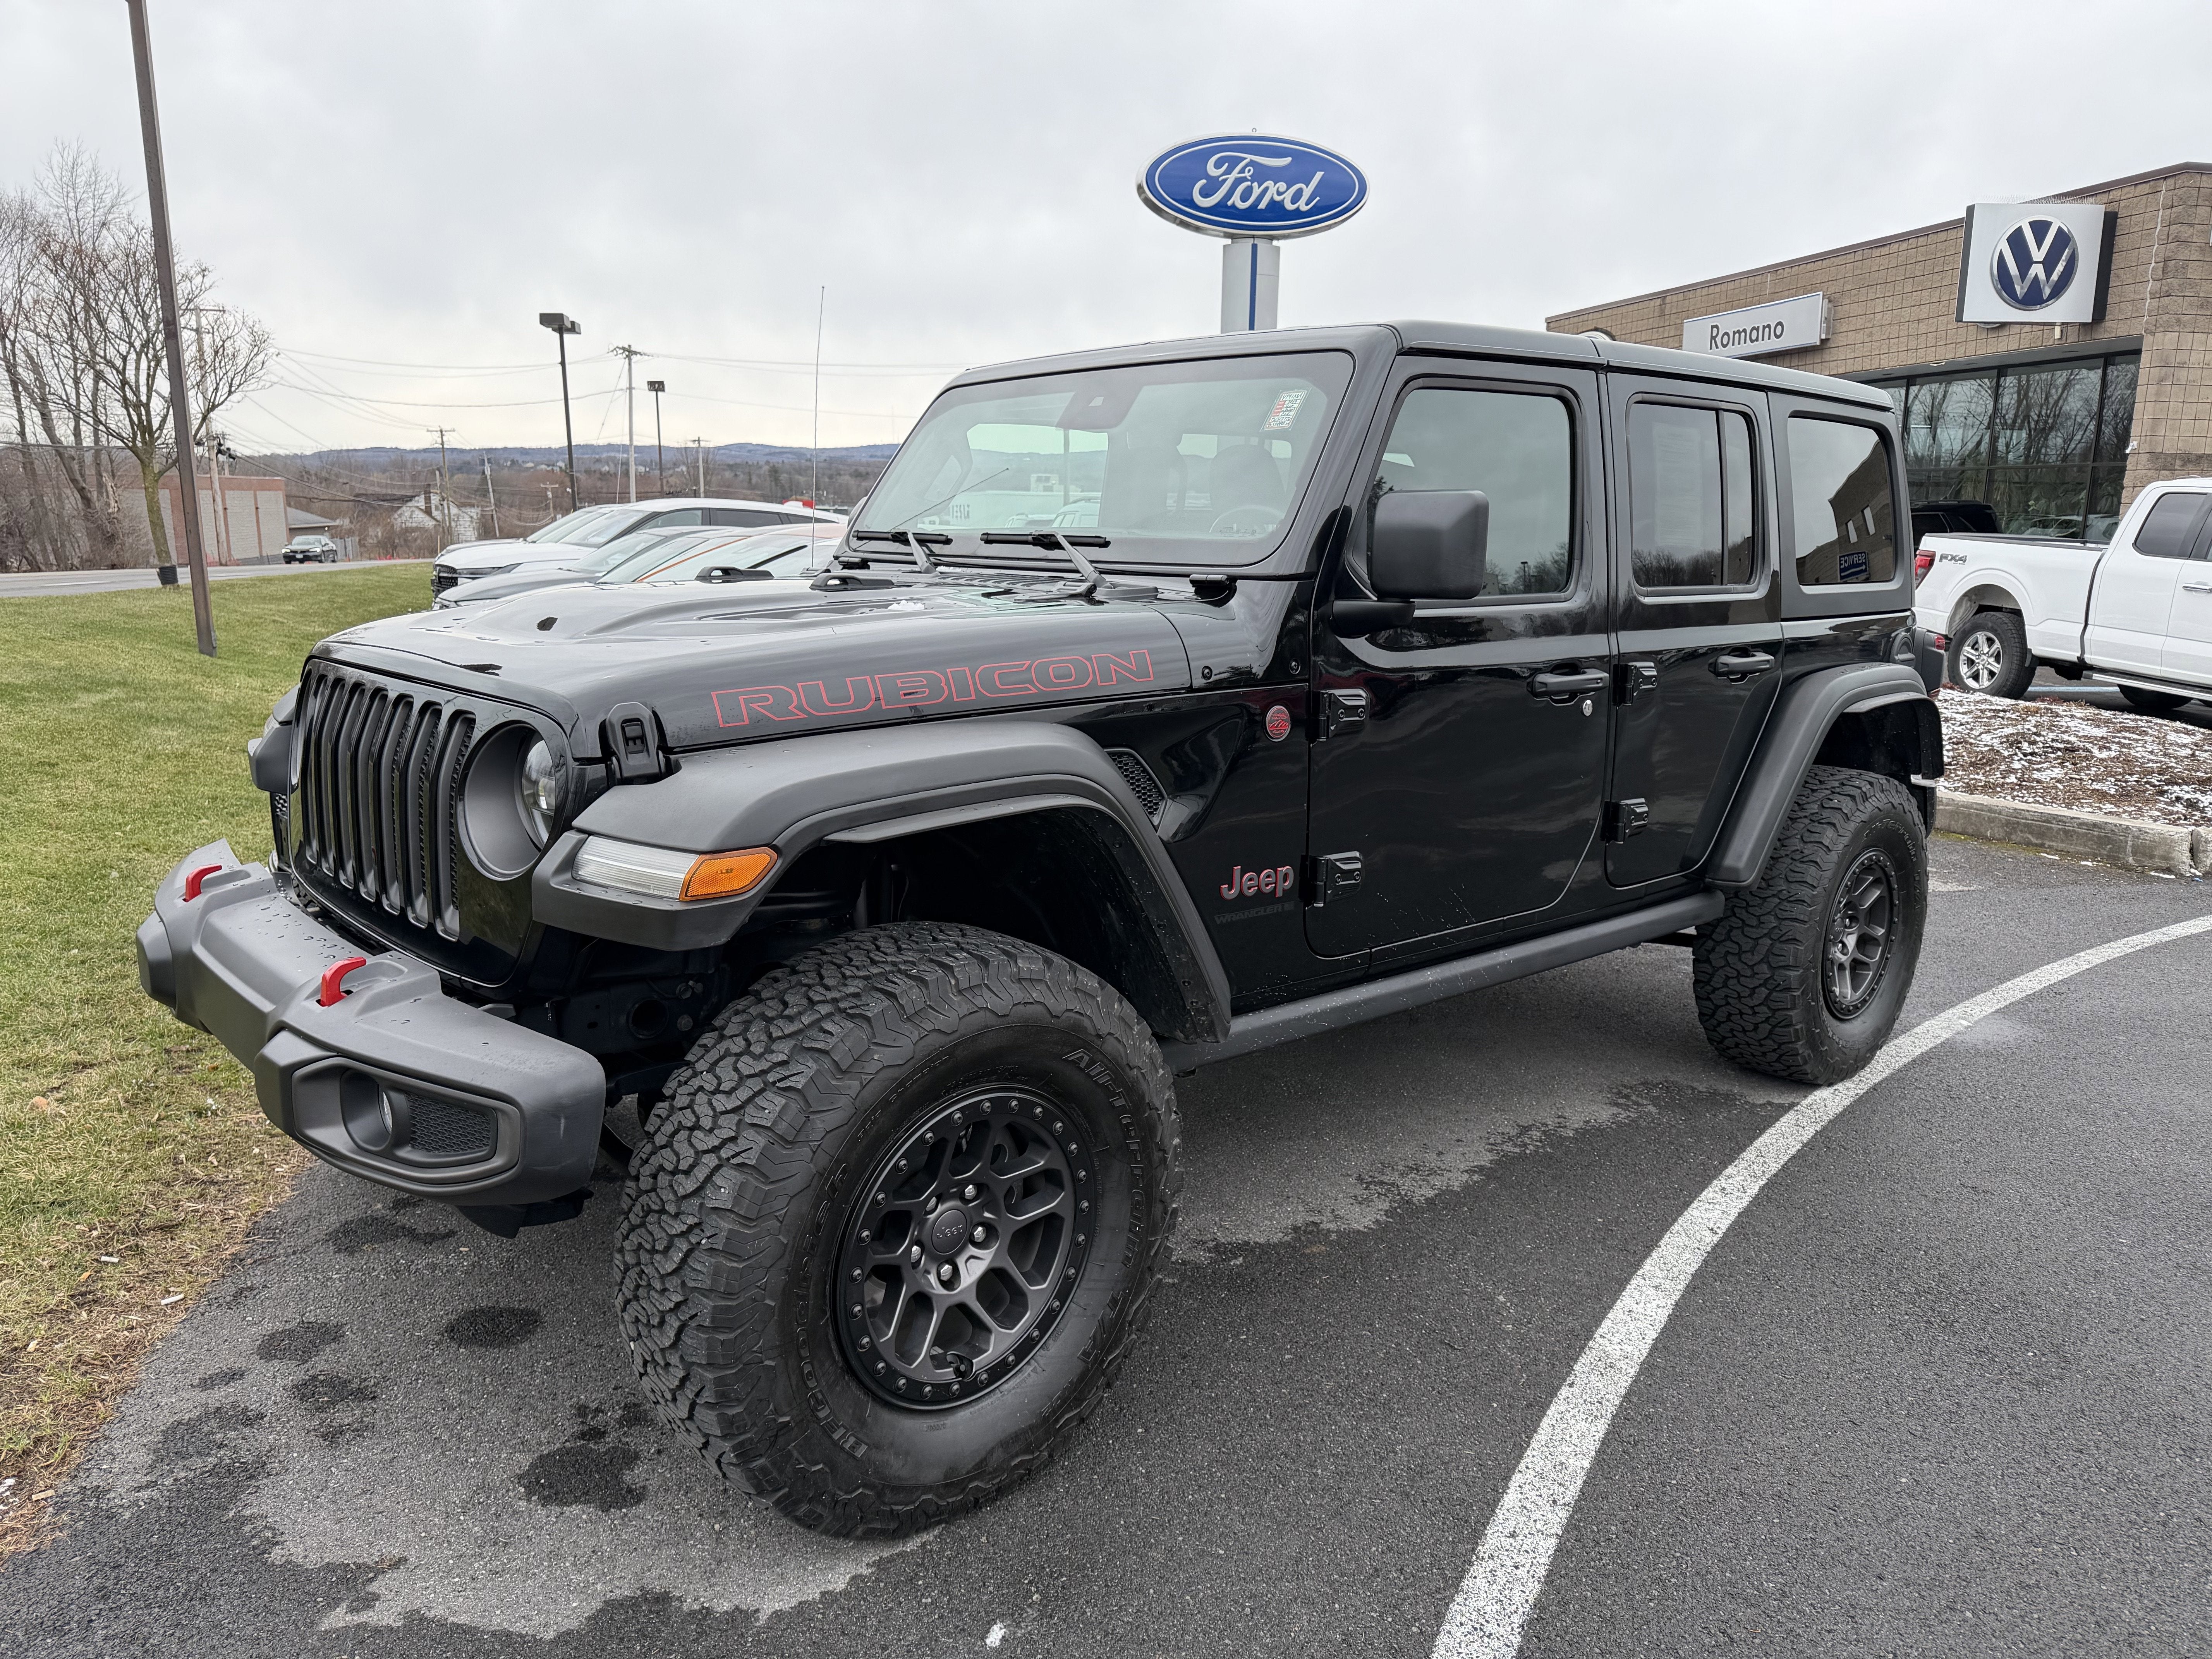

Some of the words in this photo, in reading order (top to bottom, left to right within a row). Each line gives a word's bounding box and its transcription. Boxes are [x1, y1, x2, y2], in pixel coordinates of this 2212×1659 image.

[1192, 151, 1324, 212] Ford
[1709, 321, 1784, 350] Romano
[1939, 553, 1968, 563] FX4
[711, 649, 1155, 727] RUBICON
[1219, 866, 1294, 900] Jeep
[1214, 905, 1282, 924] WRANGLER
[793, 1162, 869, 1460] BFGoodrich
